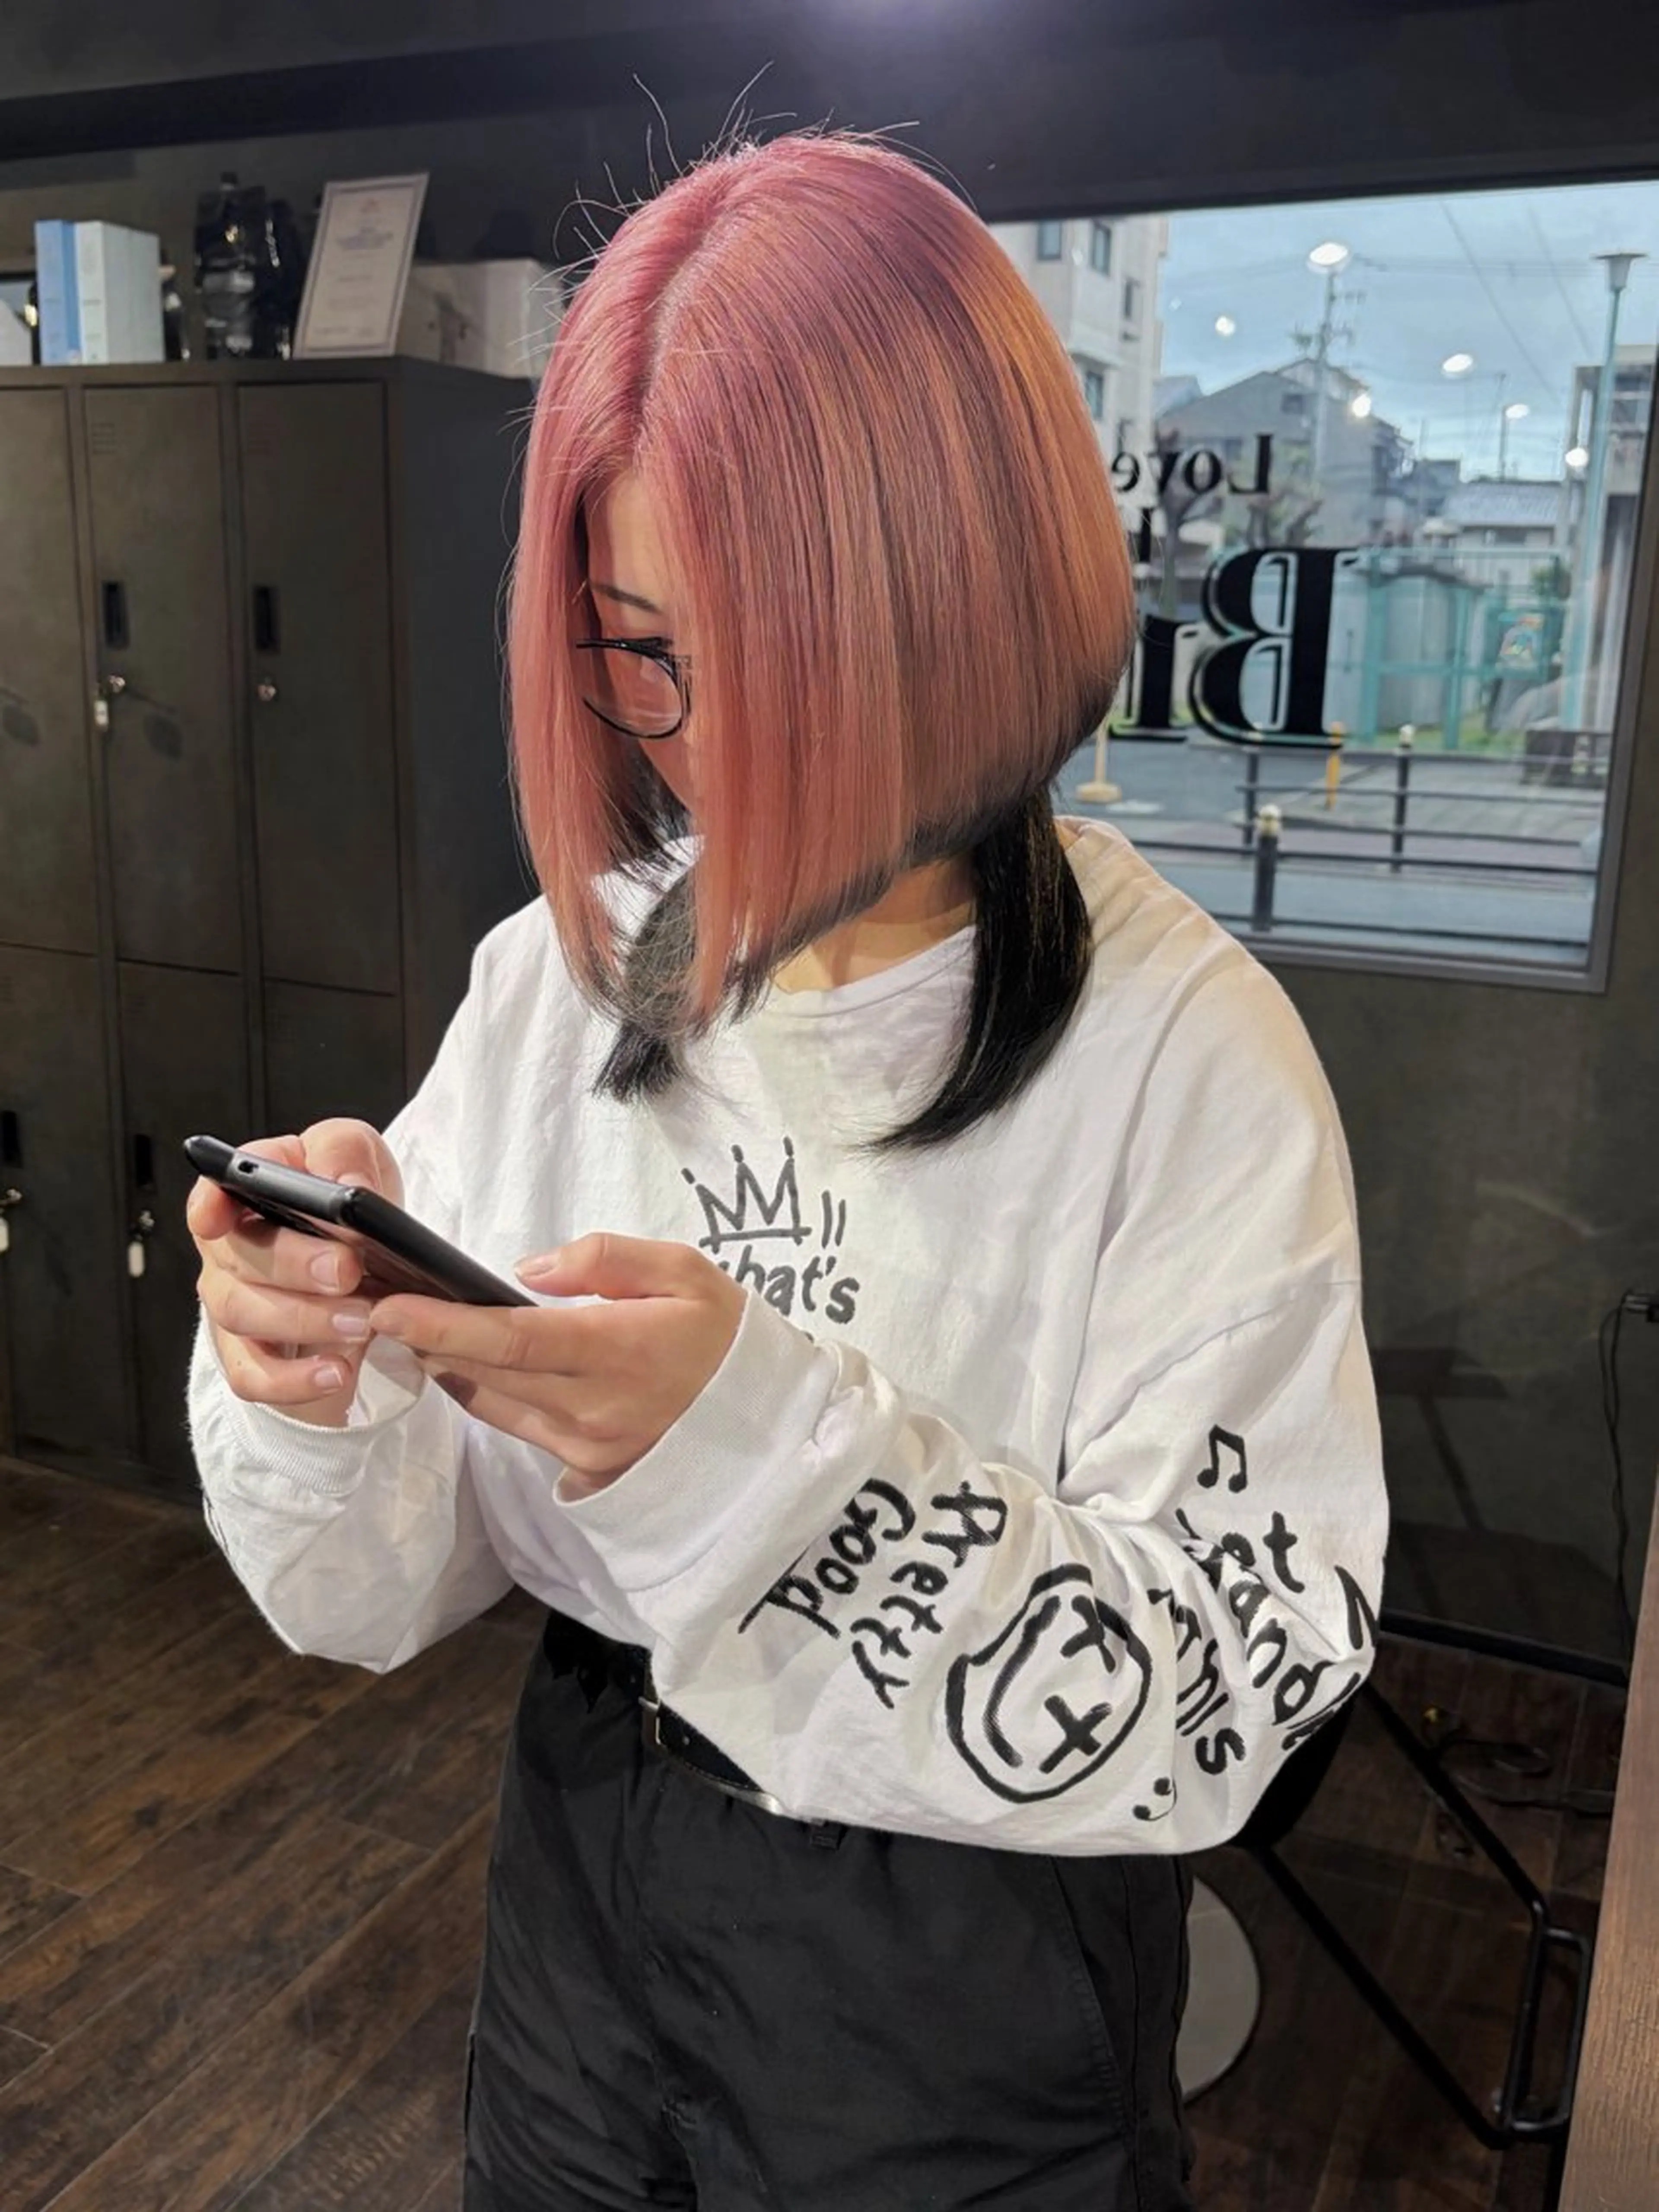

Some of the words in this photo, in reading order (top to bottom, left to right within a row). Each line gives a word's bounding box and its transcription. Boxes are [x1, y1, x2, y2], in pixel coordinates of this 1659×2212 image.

[717, 1244, 860, 1325] hat's
[764, 1478, 916, 1640] Good
[850, 1480, 1008, 1709] Pretty
